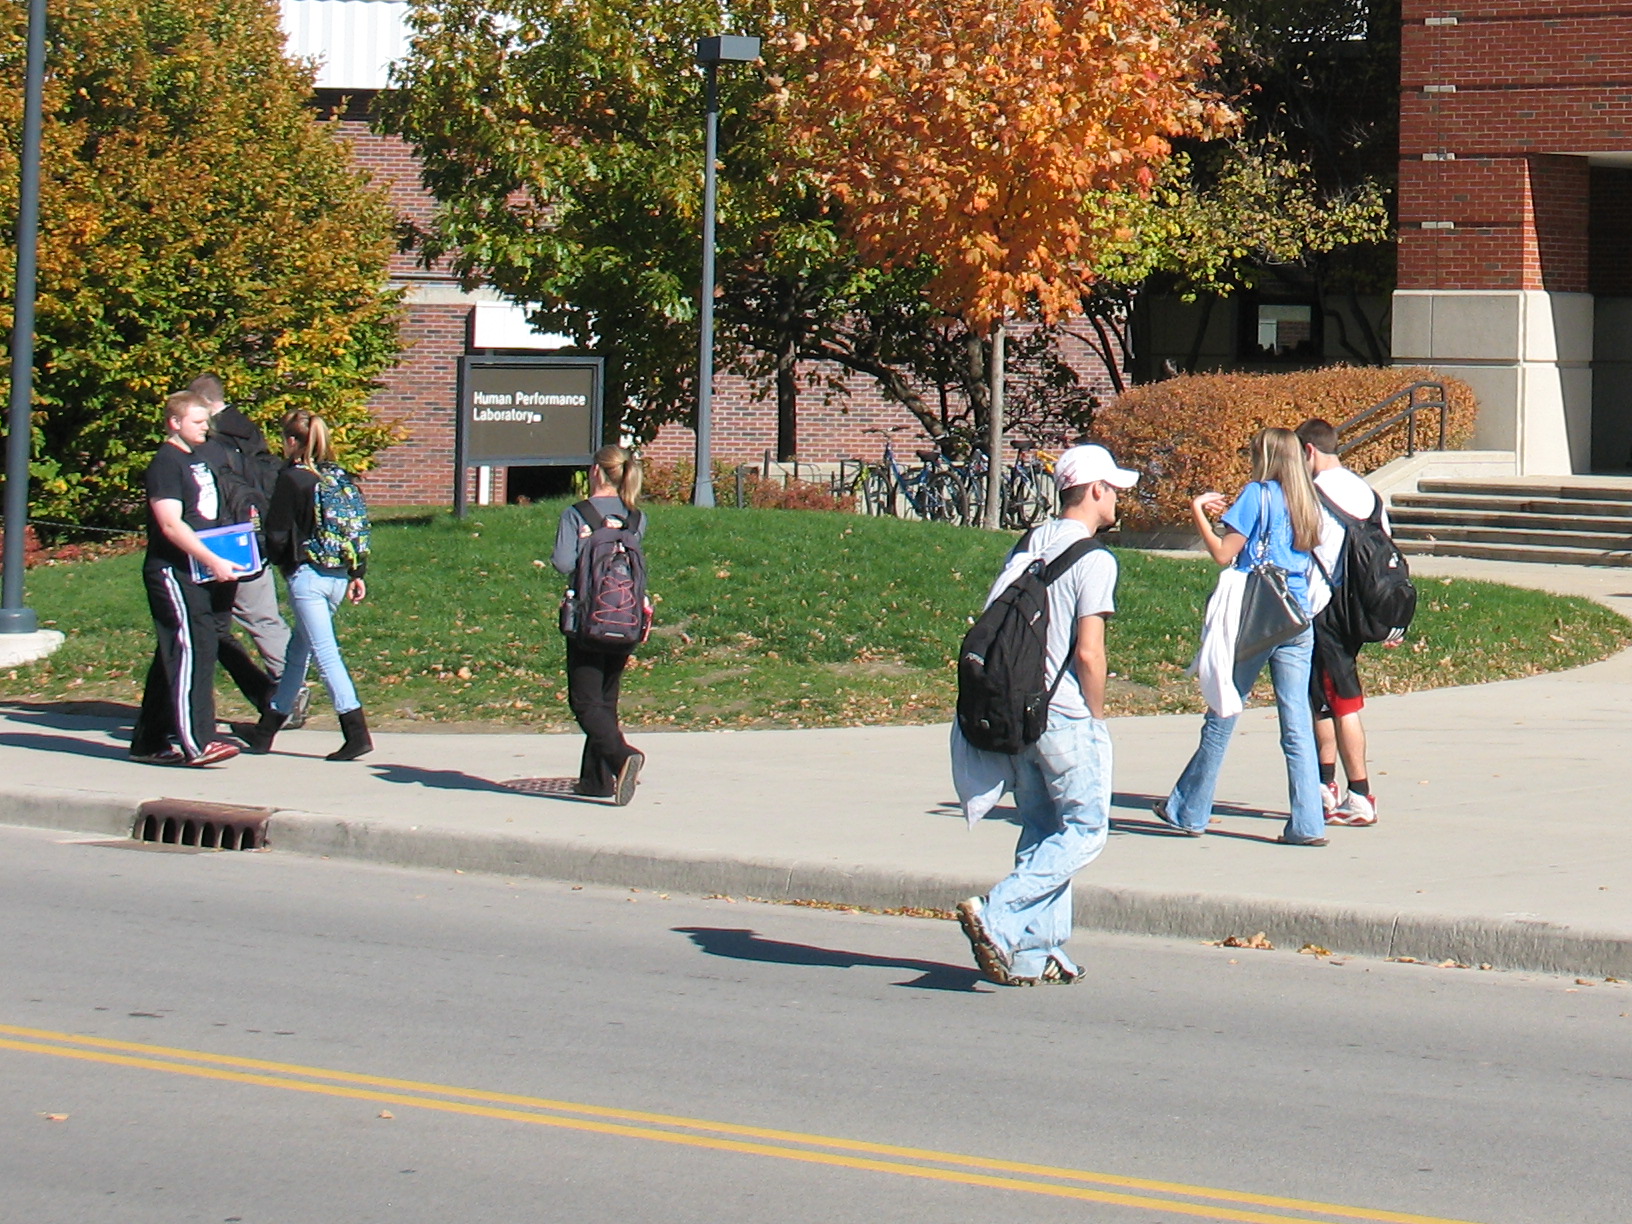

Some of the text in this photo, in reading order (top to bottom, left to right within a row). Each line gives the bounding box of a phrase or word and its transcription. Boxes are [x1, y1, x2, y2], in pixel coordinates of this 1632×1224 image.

[473, 391, 586, 406] Human Performance
[473, 408, 534, 424] Laboratory
